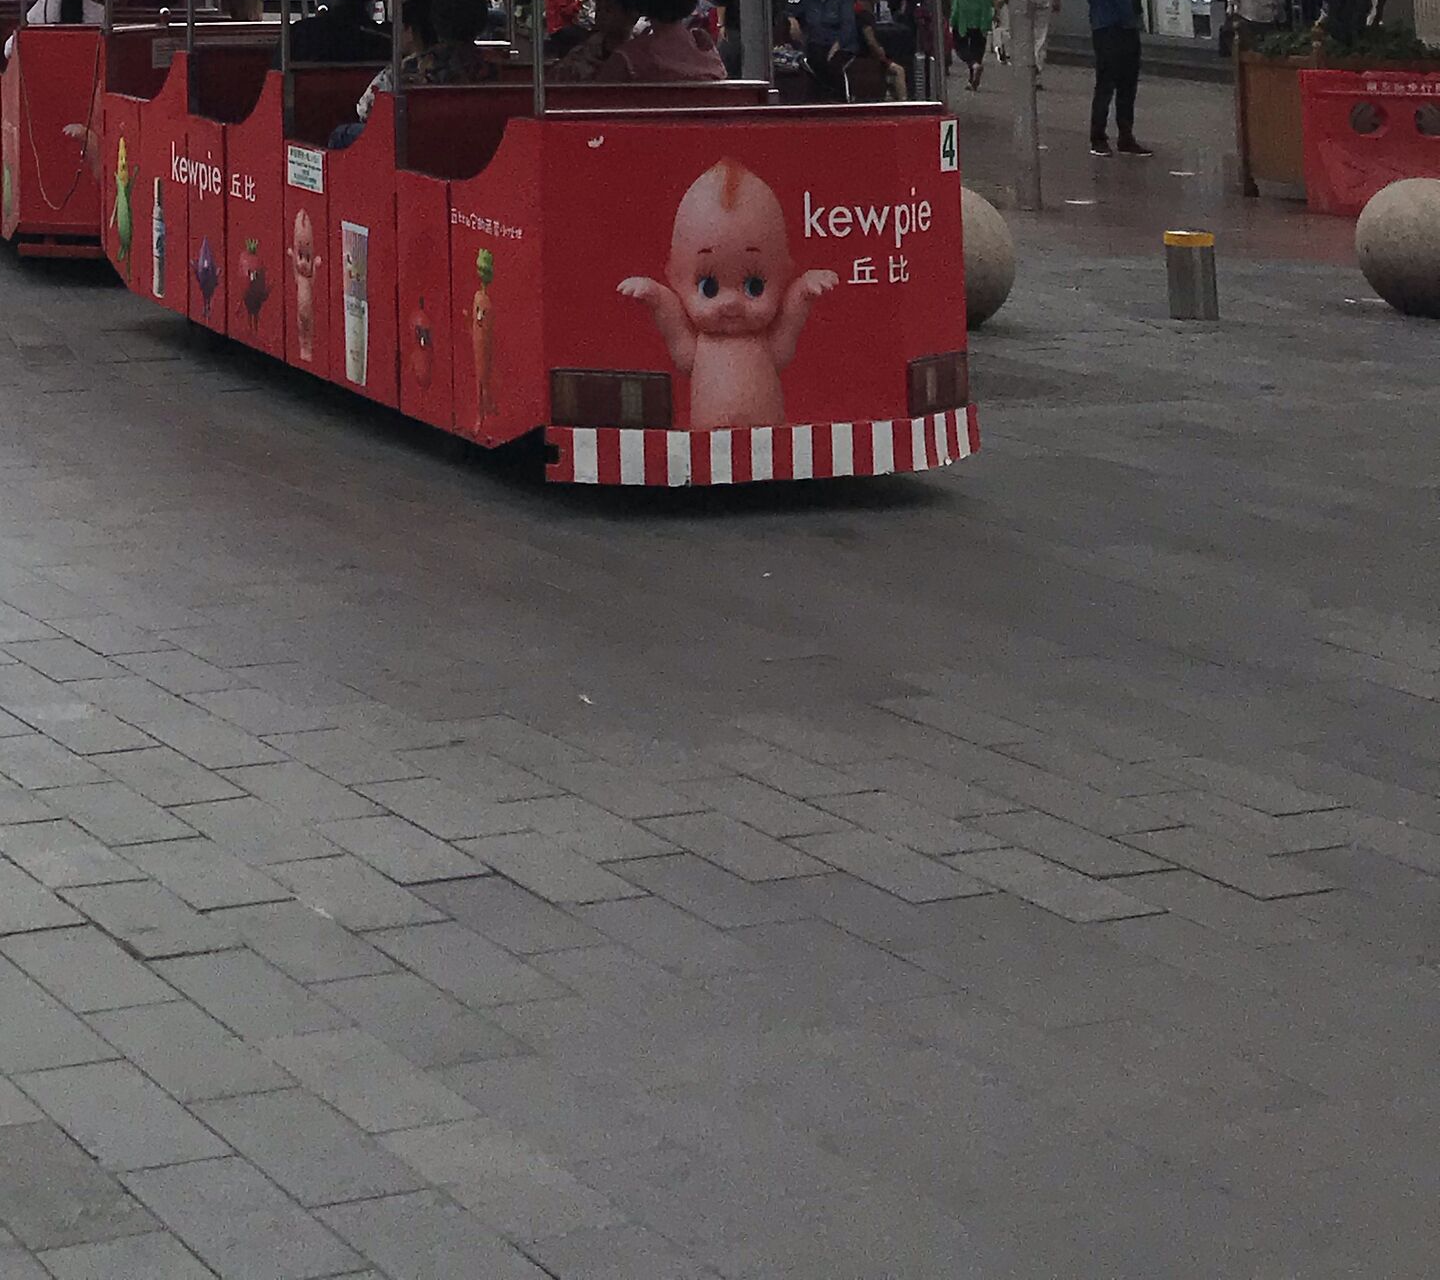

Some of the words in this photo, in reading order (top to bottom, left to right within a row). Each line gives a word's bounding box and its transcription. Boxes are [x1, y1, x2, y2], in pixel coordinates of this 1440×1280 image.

[942, 124, 956, 166] 4
[171, 141, 222, 200] kewpie
[230, 173, 256, 202] 丘比
[804, 187, 932, 248] kewpie
[848, 255, 910, 284] 丘比
